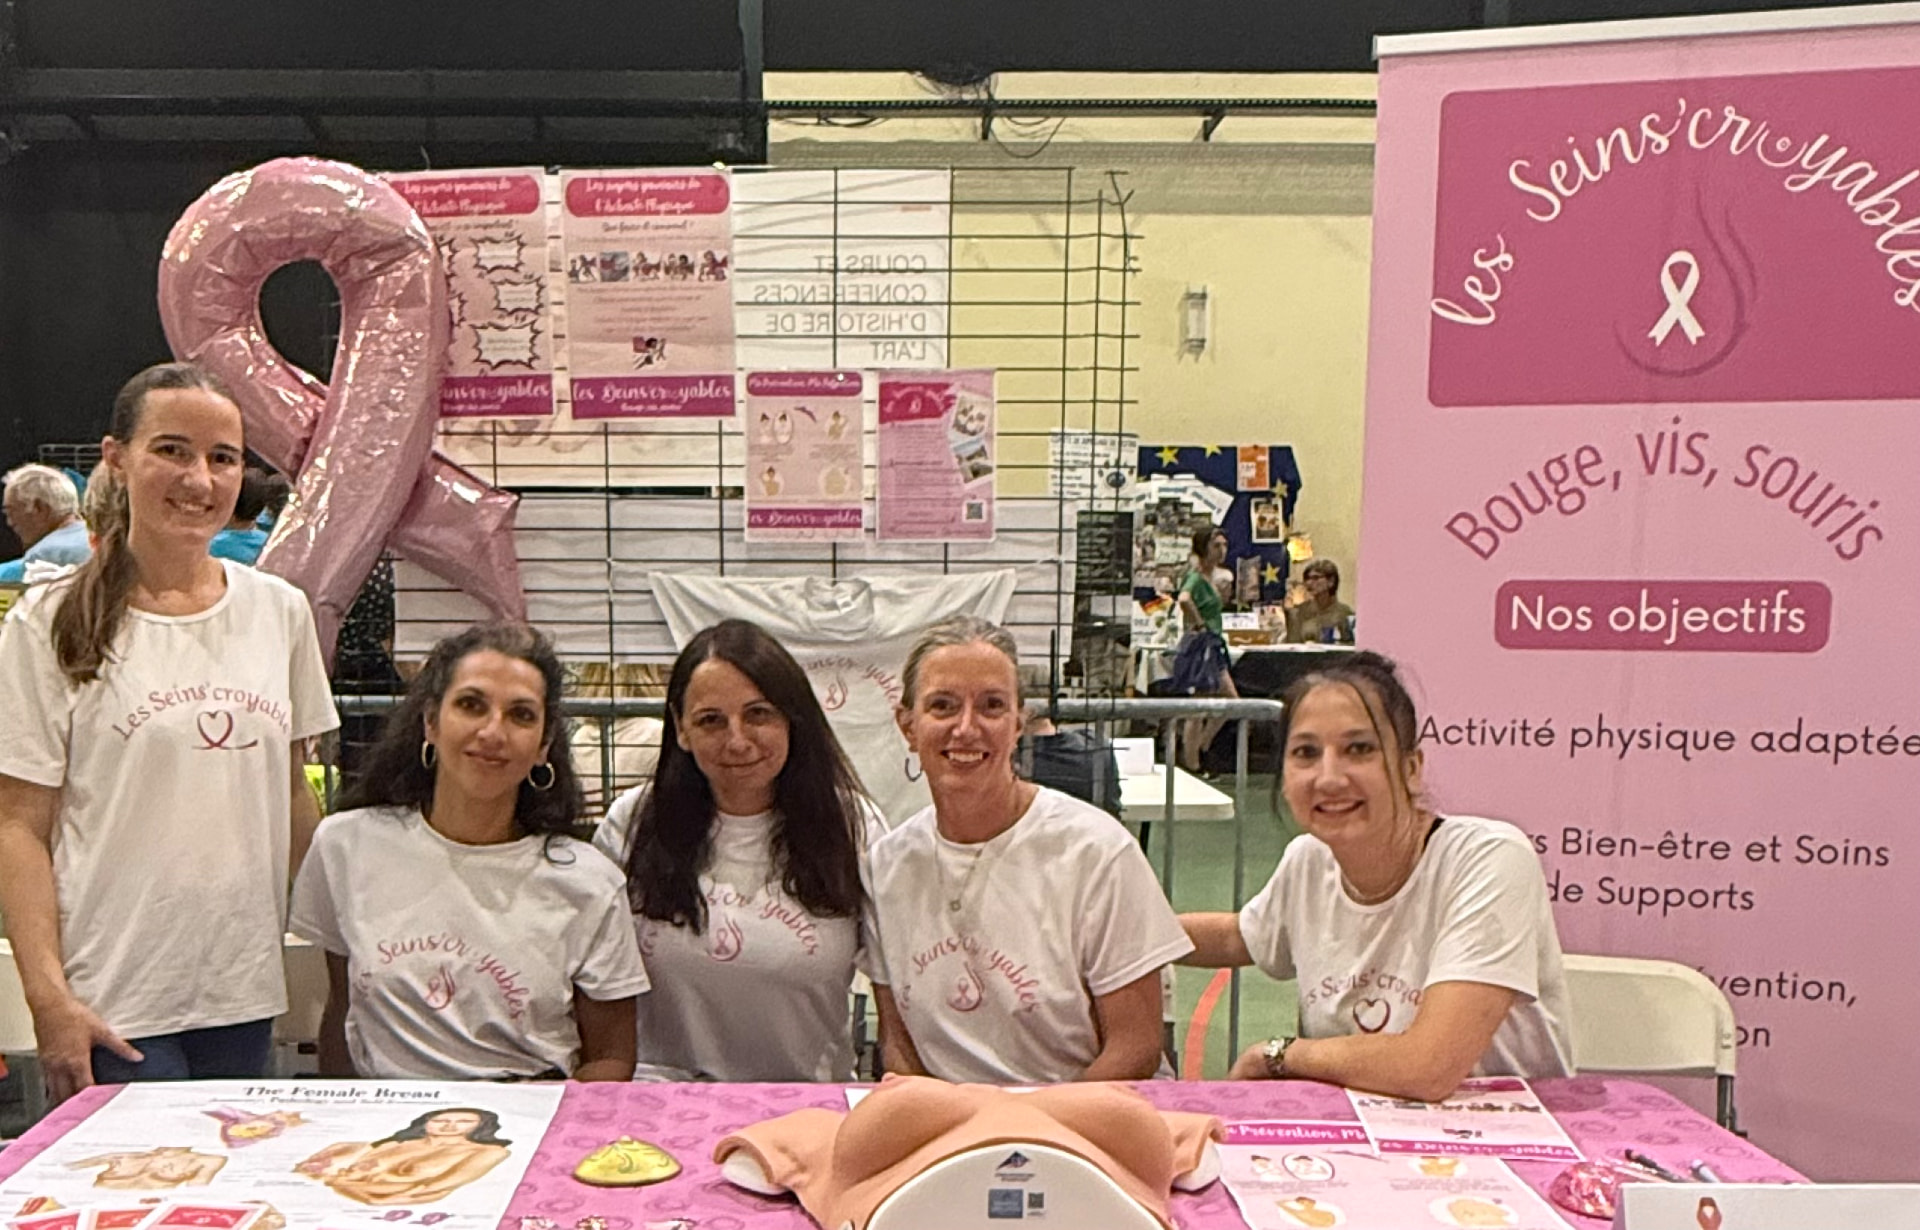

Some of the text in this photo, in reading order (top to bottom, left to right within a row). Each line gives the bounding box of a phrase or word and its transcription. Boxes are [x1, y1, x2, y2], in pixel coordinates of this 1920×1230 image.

[1444, 415, 1883, 561] Bouge, vis, souris
[1511, 589, 1806, 645] Nos objectifs
[1417, 713, 1920, 765] Activité physique adaptée
[1562, 827, 1731, 862] Bien-être
[1745, 836, 1782, 863] et
[1795, 835, 1890, 867] Soins
[1547, 869, 1755, 917] de Supports
[242, 1086, 441, 1099] The Female Breast
